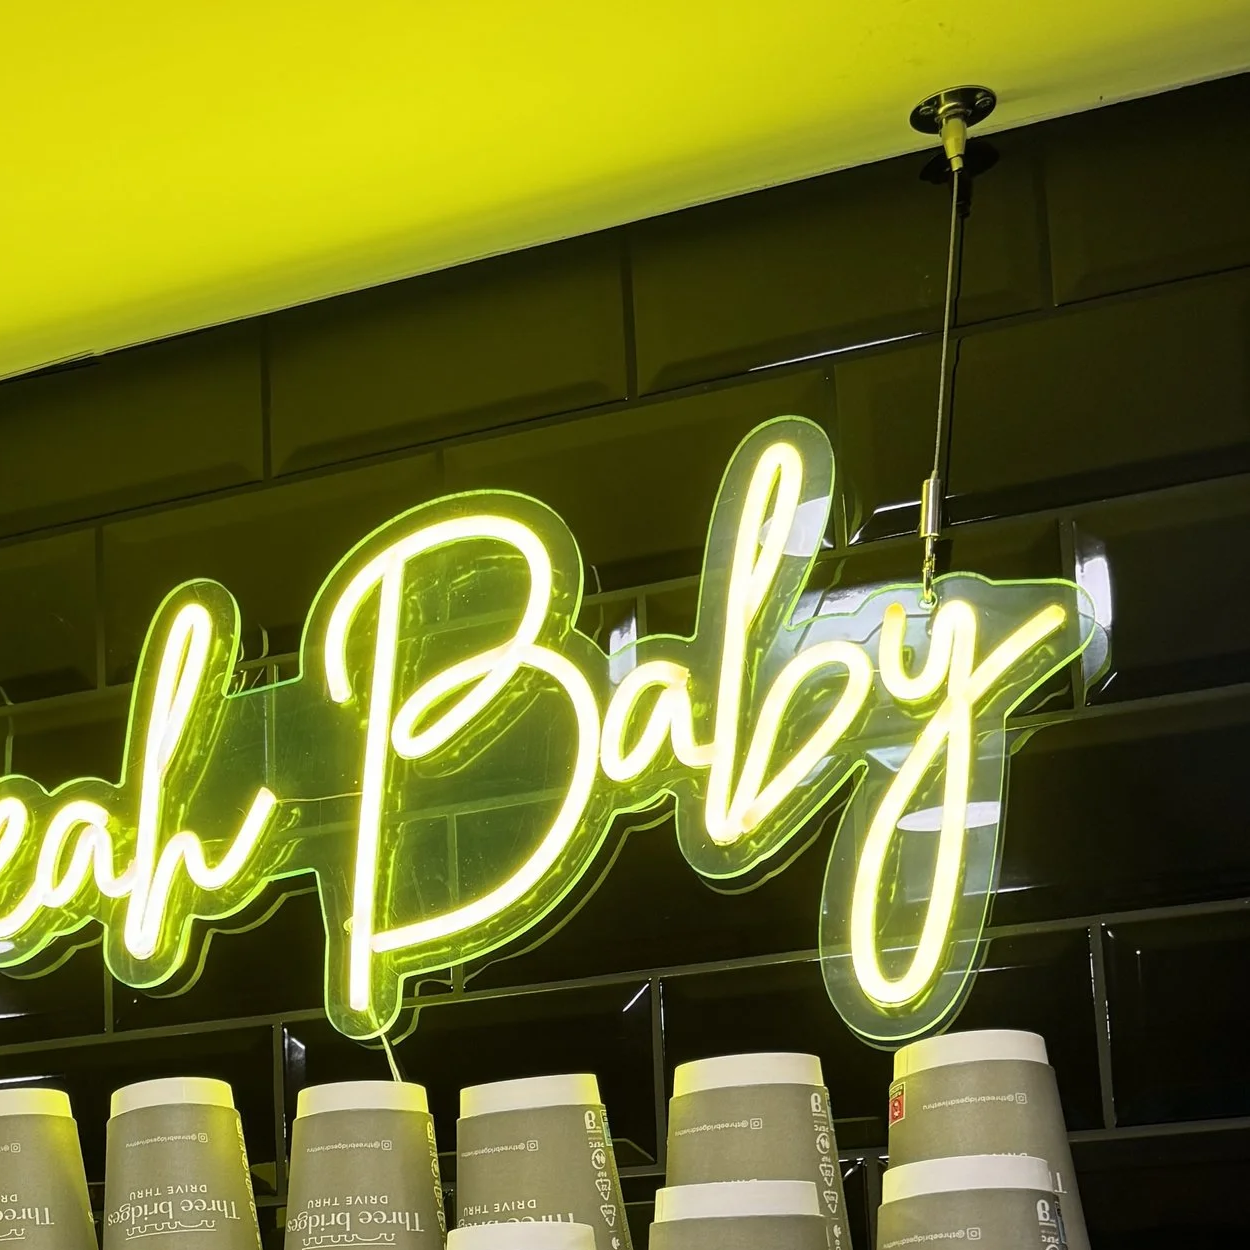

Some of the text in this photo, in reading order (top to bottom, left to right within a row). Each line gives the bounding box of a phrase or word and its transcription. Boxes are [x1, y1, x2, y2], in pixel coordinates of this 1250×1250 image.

[324, 438, 1068, 1013] Baby
[129, 1184, 207, 1201] DRIVE THRU
[307, 1195, 388, 1209] DRIVE THRU
[107, 1199, 241, 1226] Three bridges
[463, 1199, 536, 1216] DRIVE THRU
[287, 1211, 425, 1234] Three bridges
